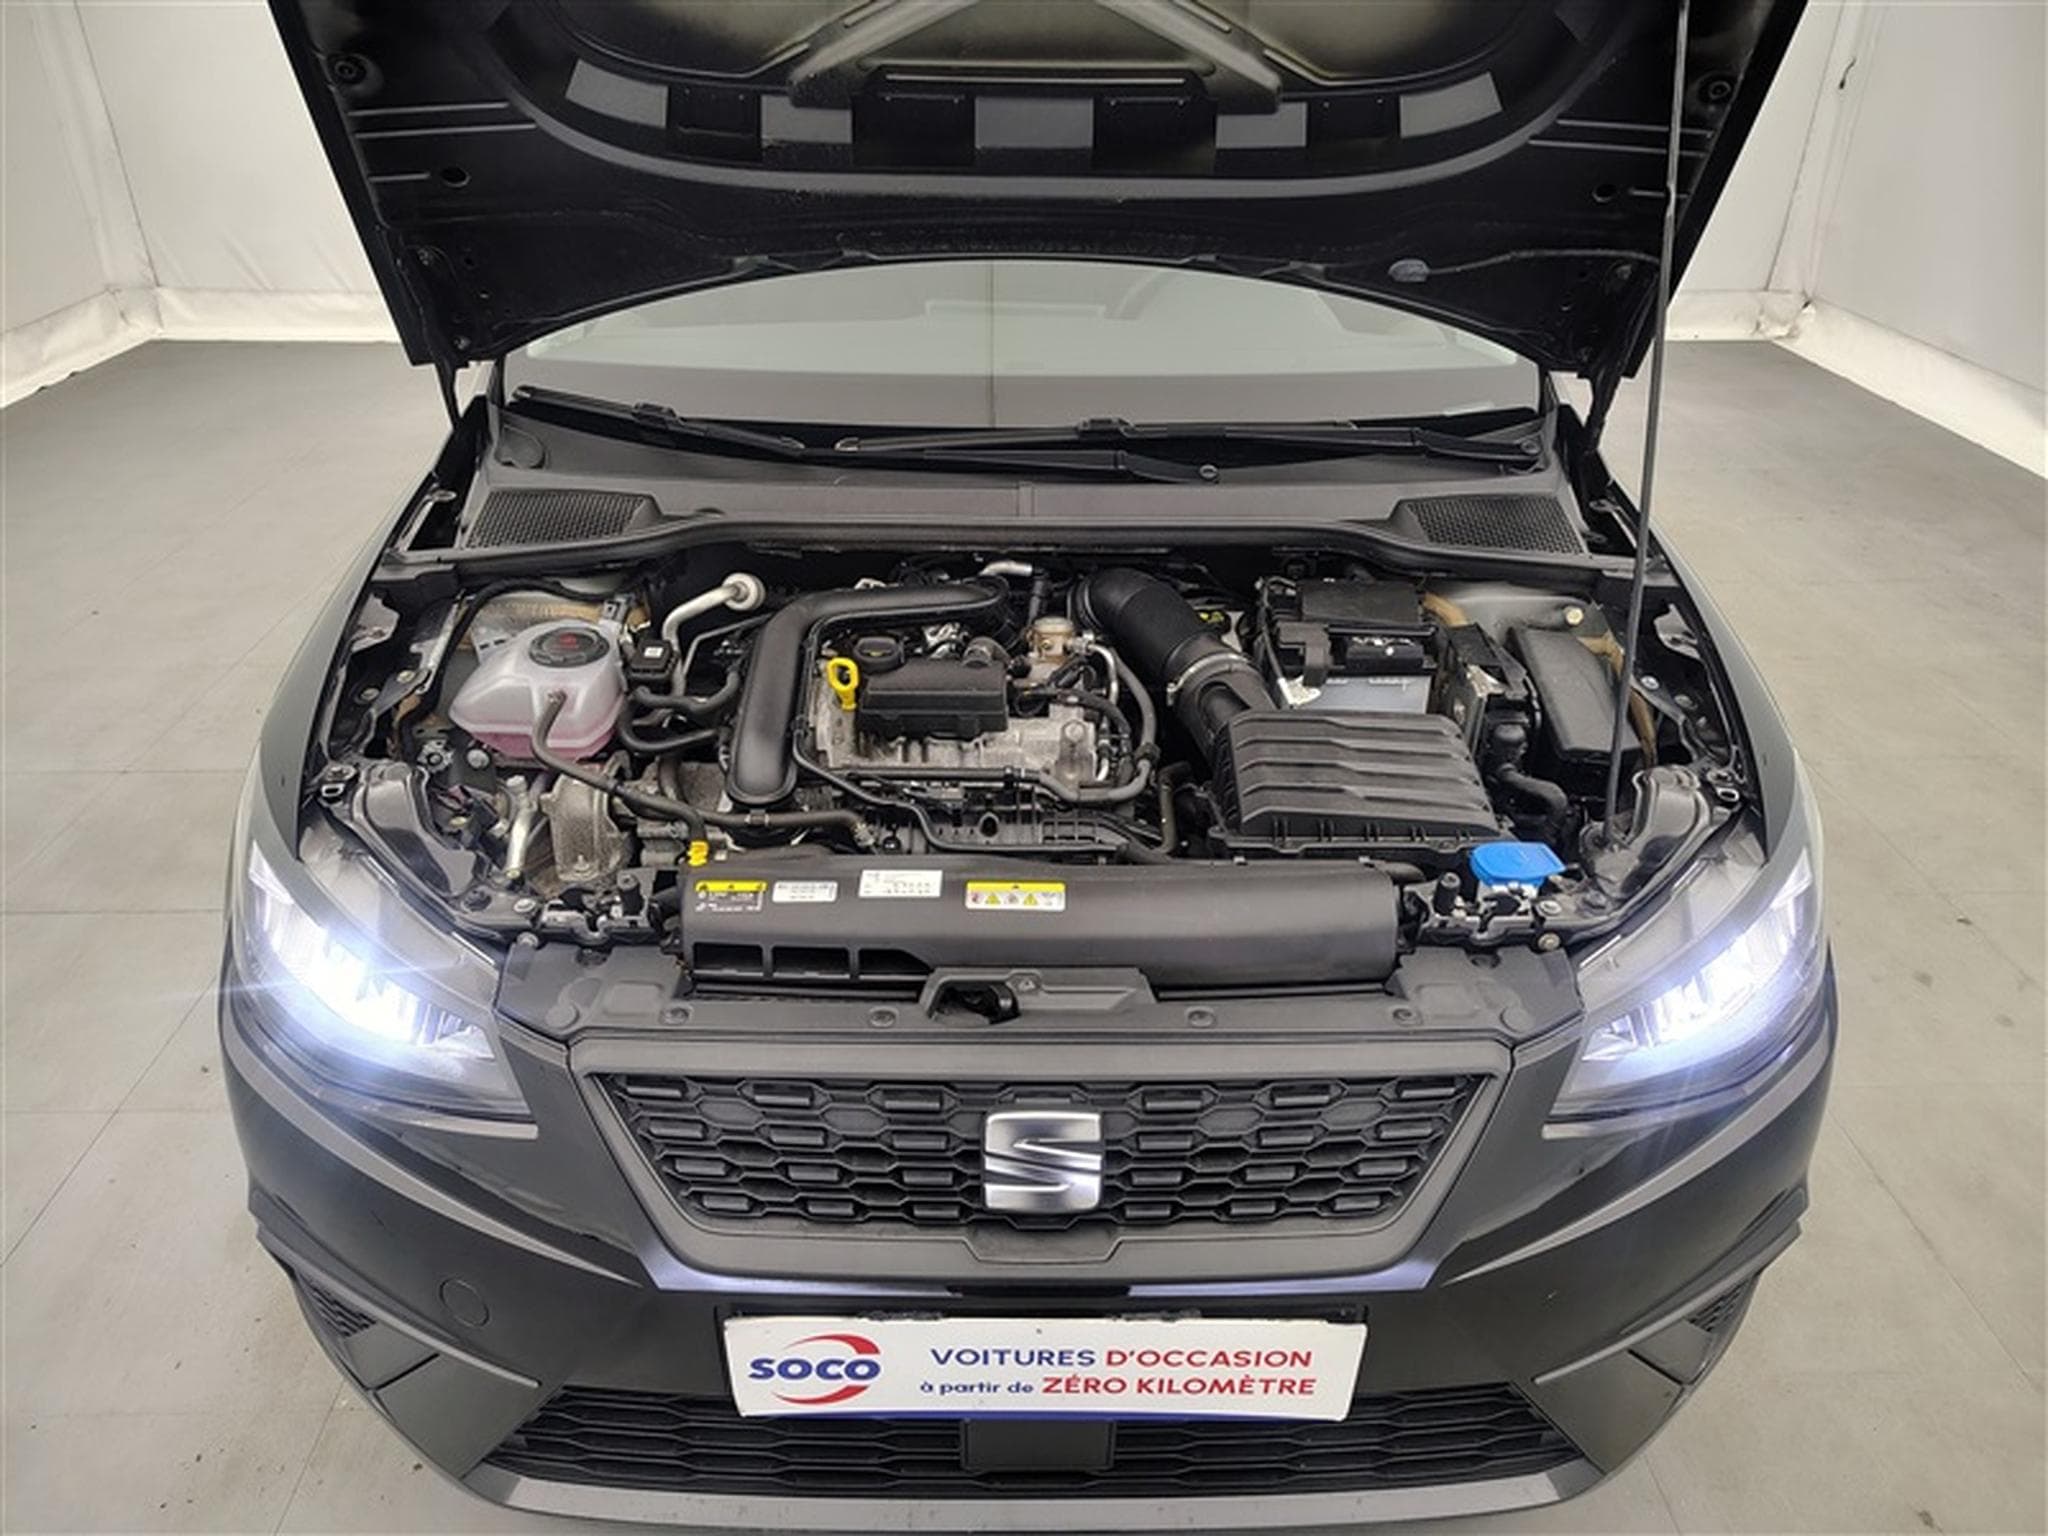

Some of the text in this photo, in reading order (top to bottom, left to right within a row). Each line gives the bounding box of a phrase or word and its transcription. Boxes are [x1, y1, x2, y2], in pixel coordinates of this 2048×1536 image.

[931, 1348, 1313, 1368] VOITURES D'OCCASION
[749, 1358, 881, 1381] SOCO
[920, 1374, 1317, 1396] à partir de ZÉRO KILOMÈTRE
